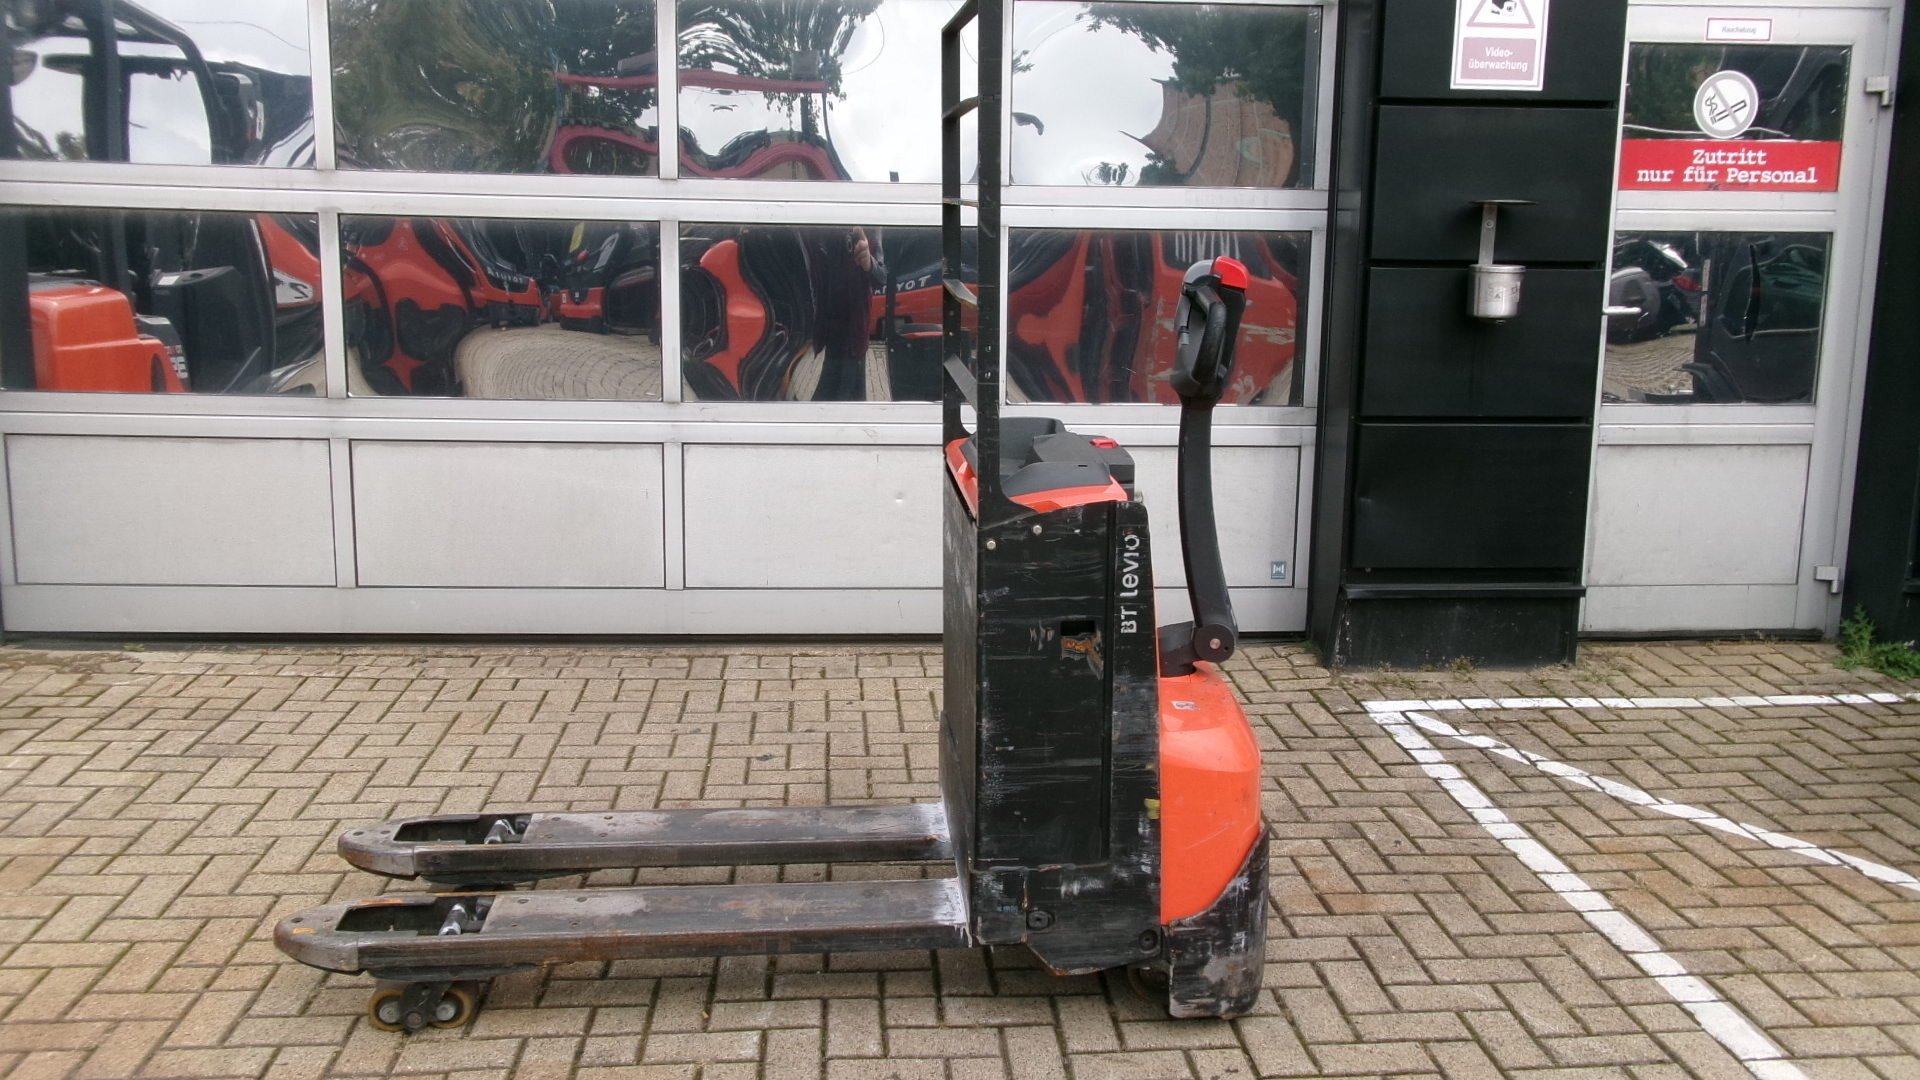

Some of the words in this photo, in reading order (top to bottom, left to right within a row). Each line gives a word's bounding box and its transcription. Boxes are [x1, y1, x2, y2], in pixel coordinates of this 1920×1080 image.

[1485, 46, 1513, 57] Video-
[1468, 59, 1528, 72] überwachung
[1692, 148, 1767, 165] Zutritt
[1637, 168, 1674, 182] nur
[1683, 166, 1719, 183] für
[1726, 167, 1818, 183] Personal
[1120, 605, 1138, 634] BT
